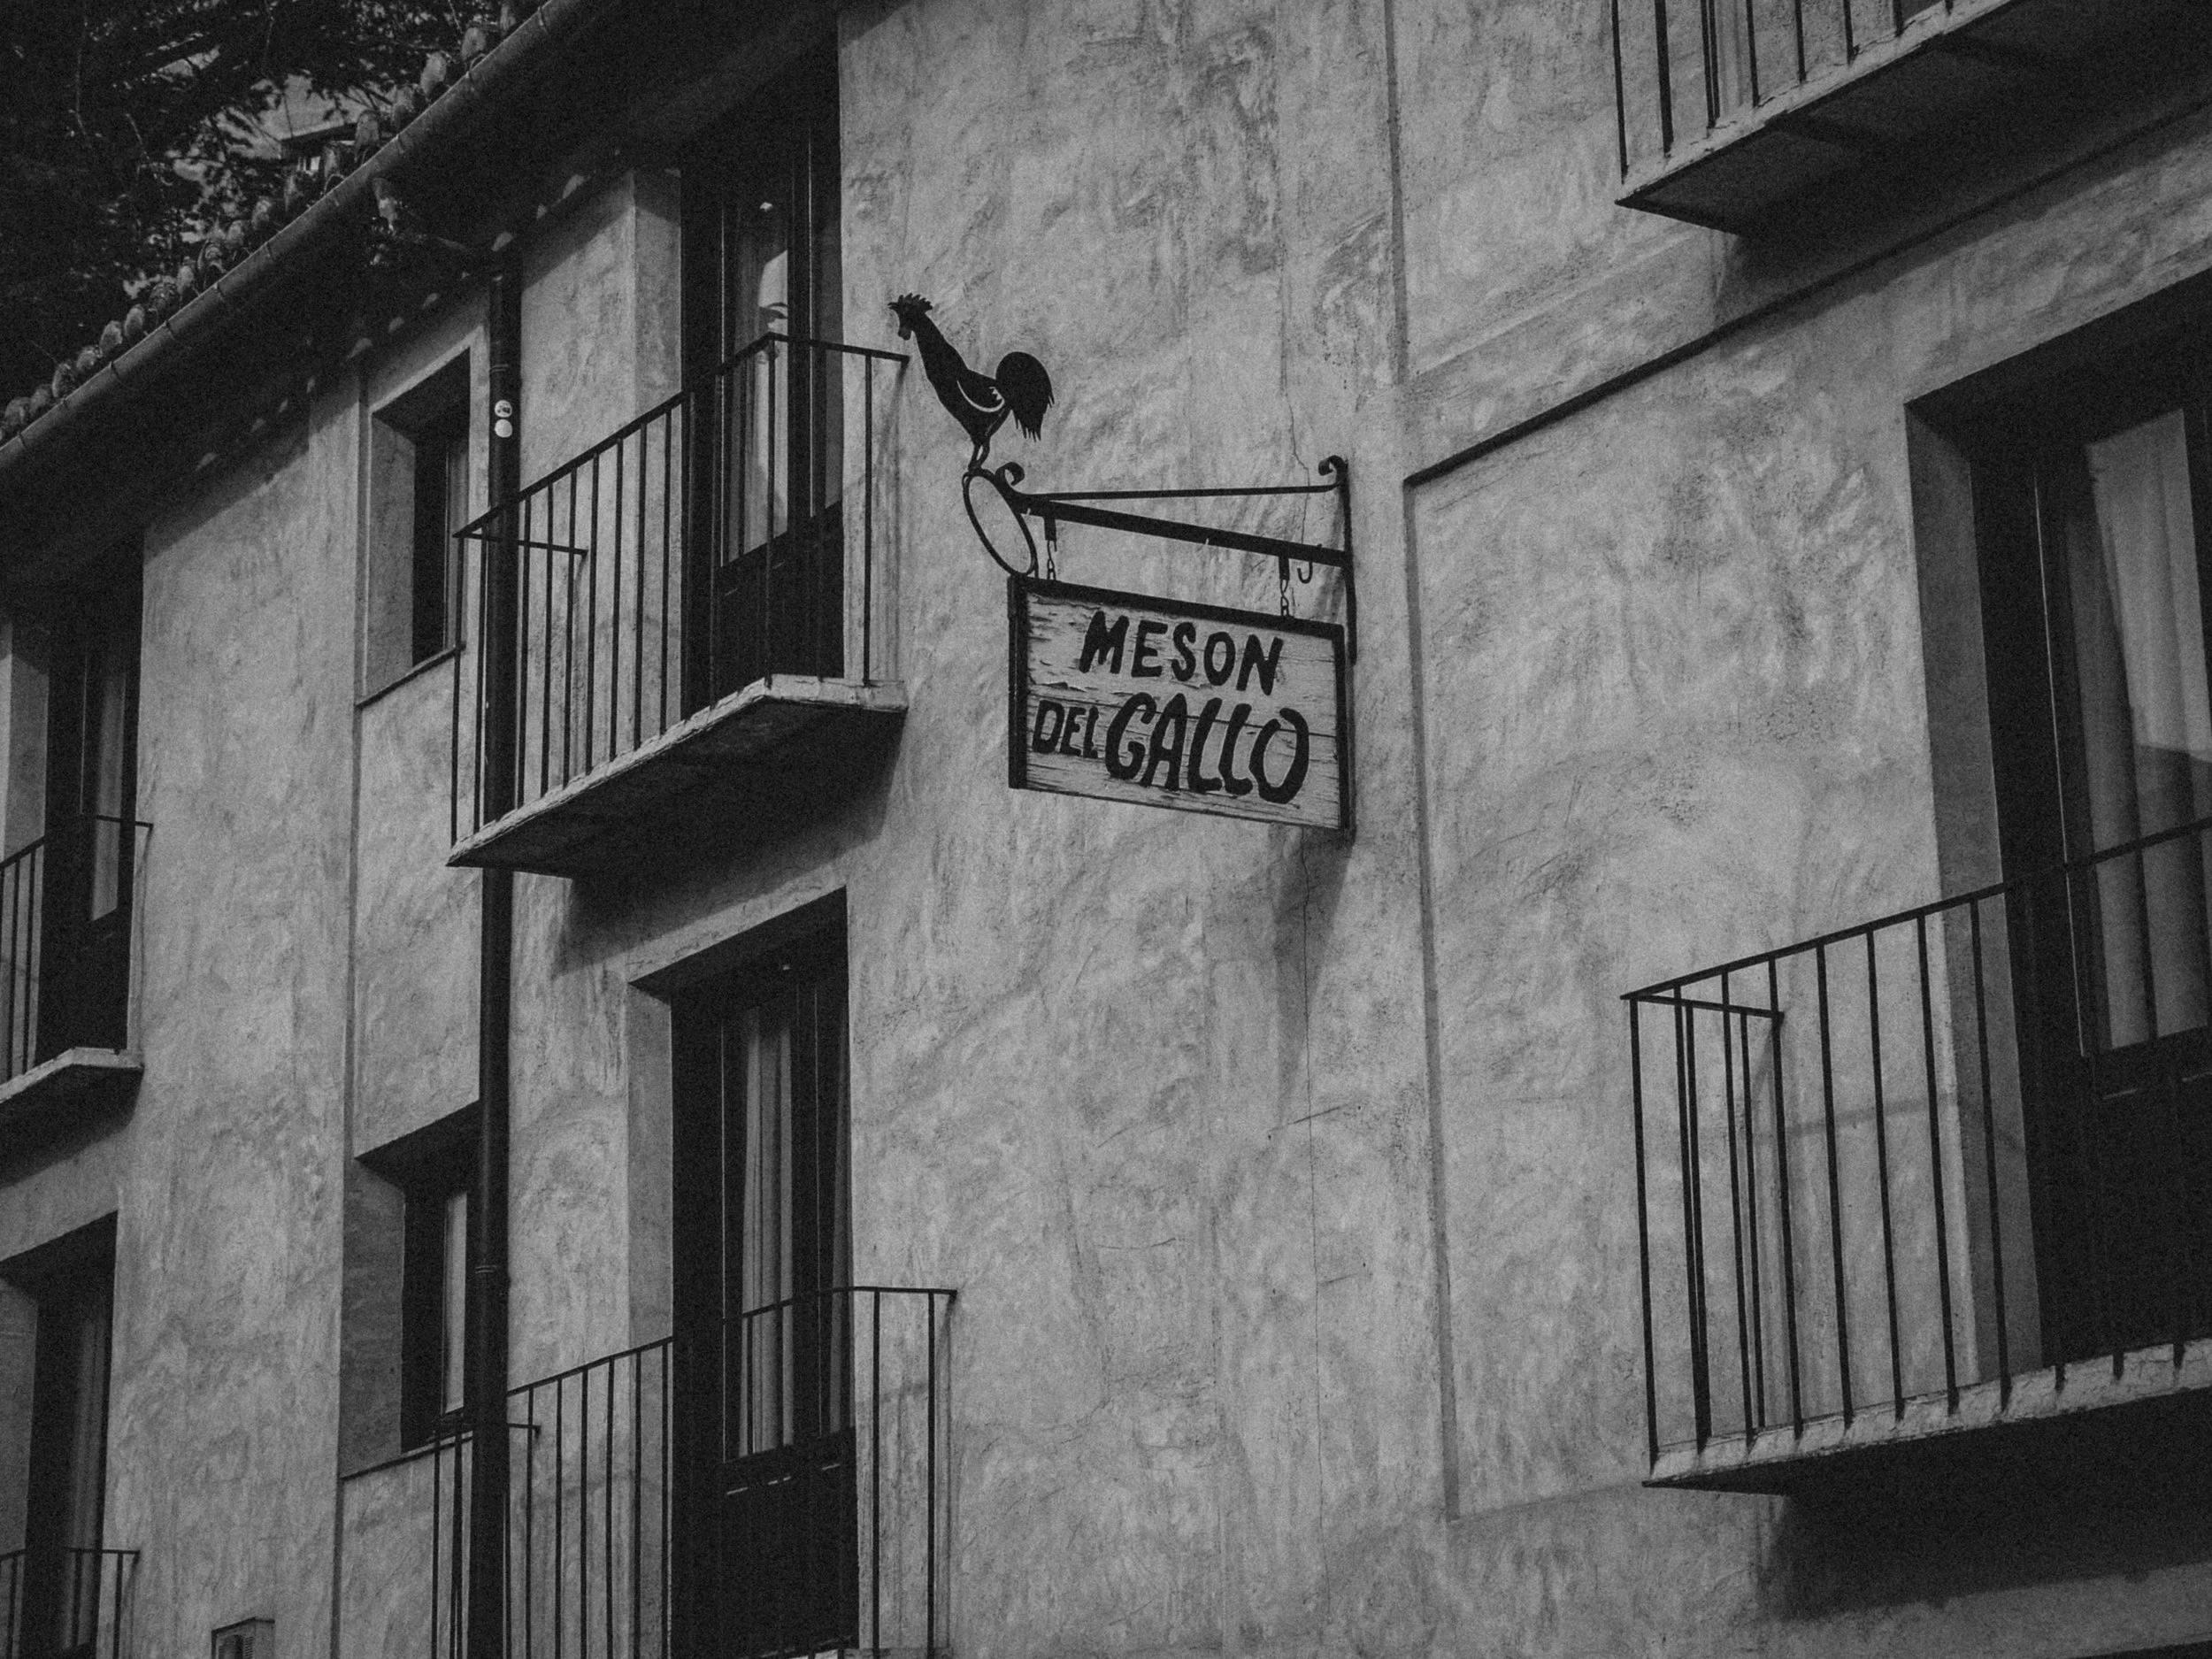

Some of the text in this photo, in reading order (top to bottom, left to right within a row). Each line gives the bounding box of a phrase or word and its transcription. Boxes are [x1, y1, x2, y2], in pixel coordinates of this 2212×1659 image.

[1079, 611, 1283, 695] MESON
[1032, 692, 1310, 804] DEL GALLO
